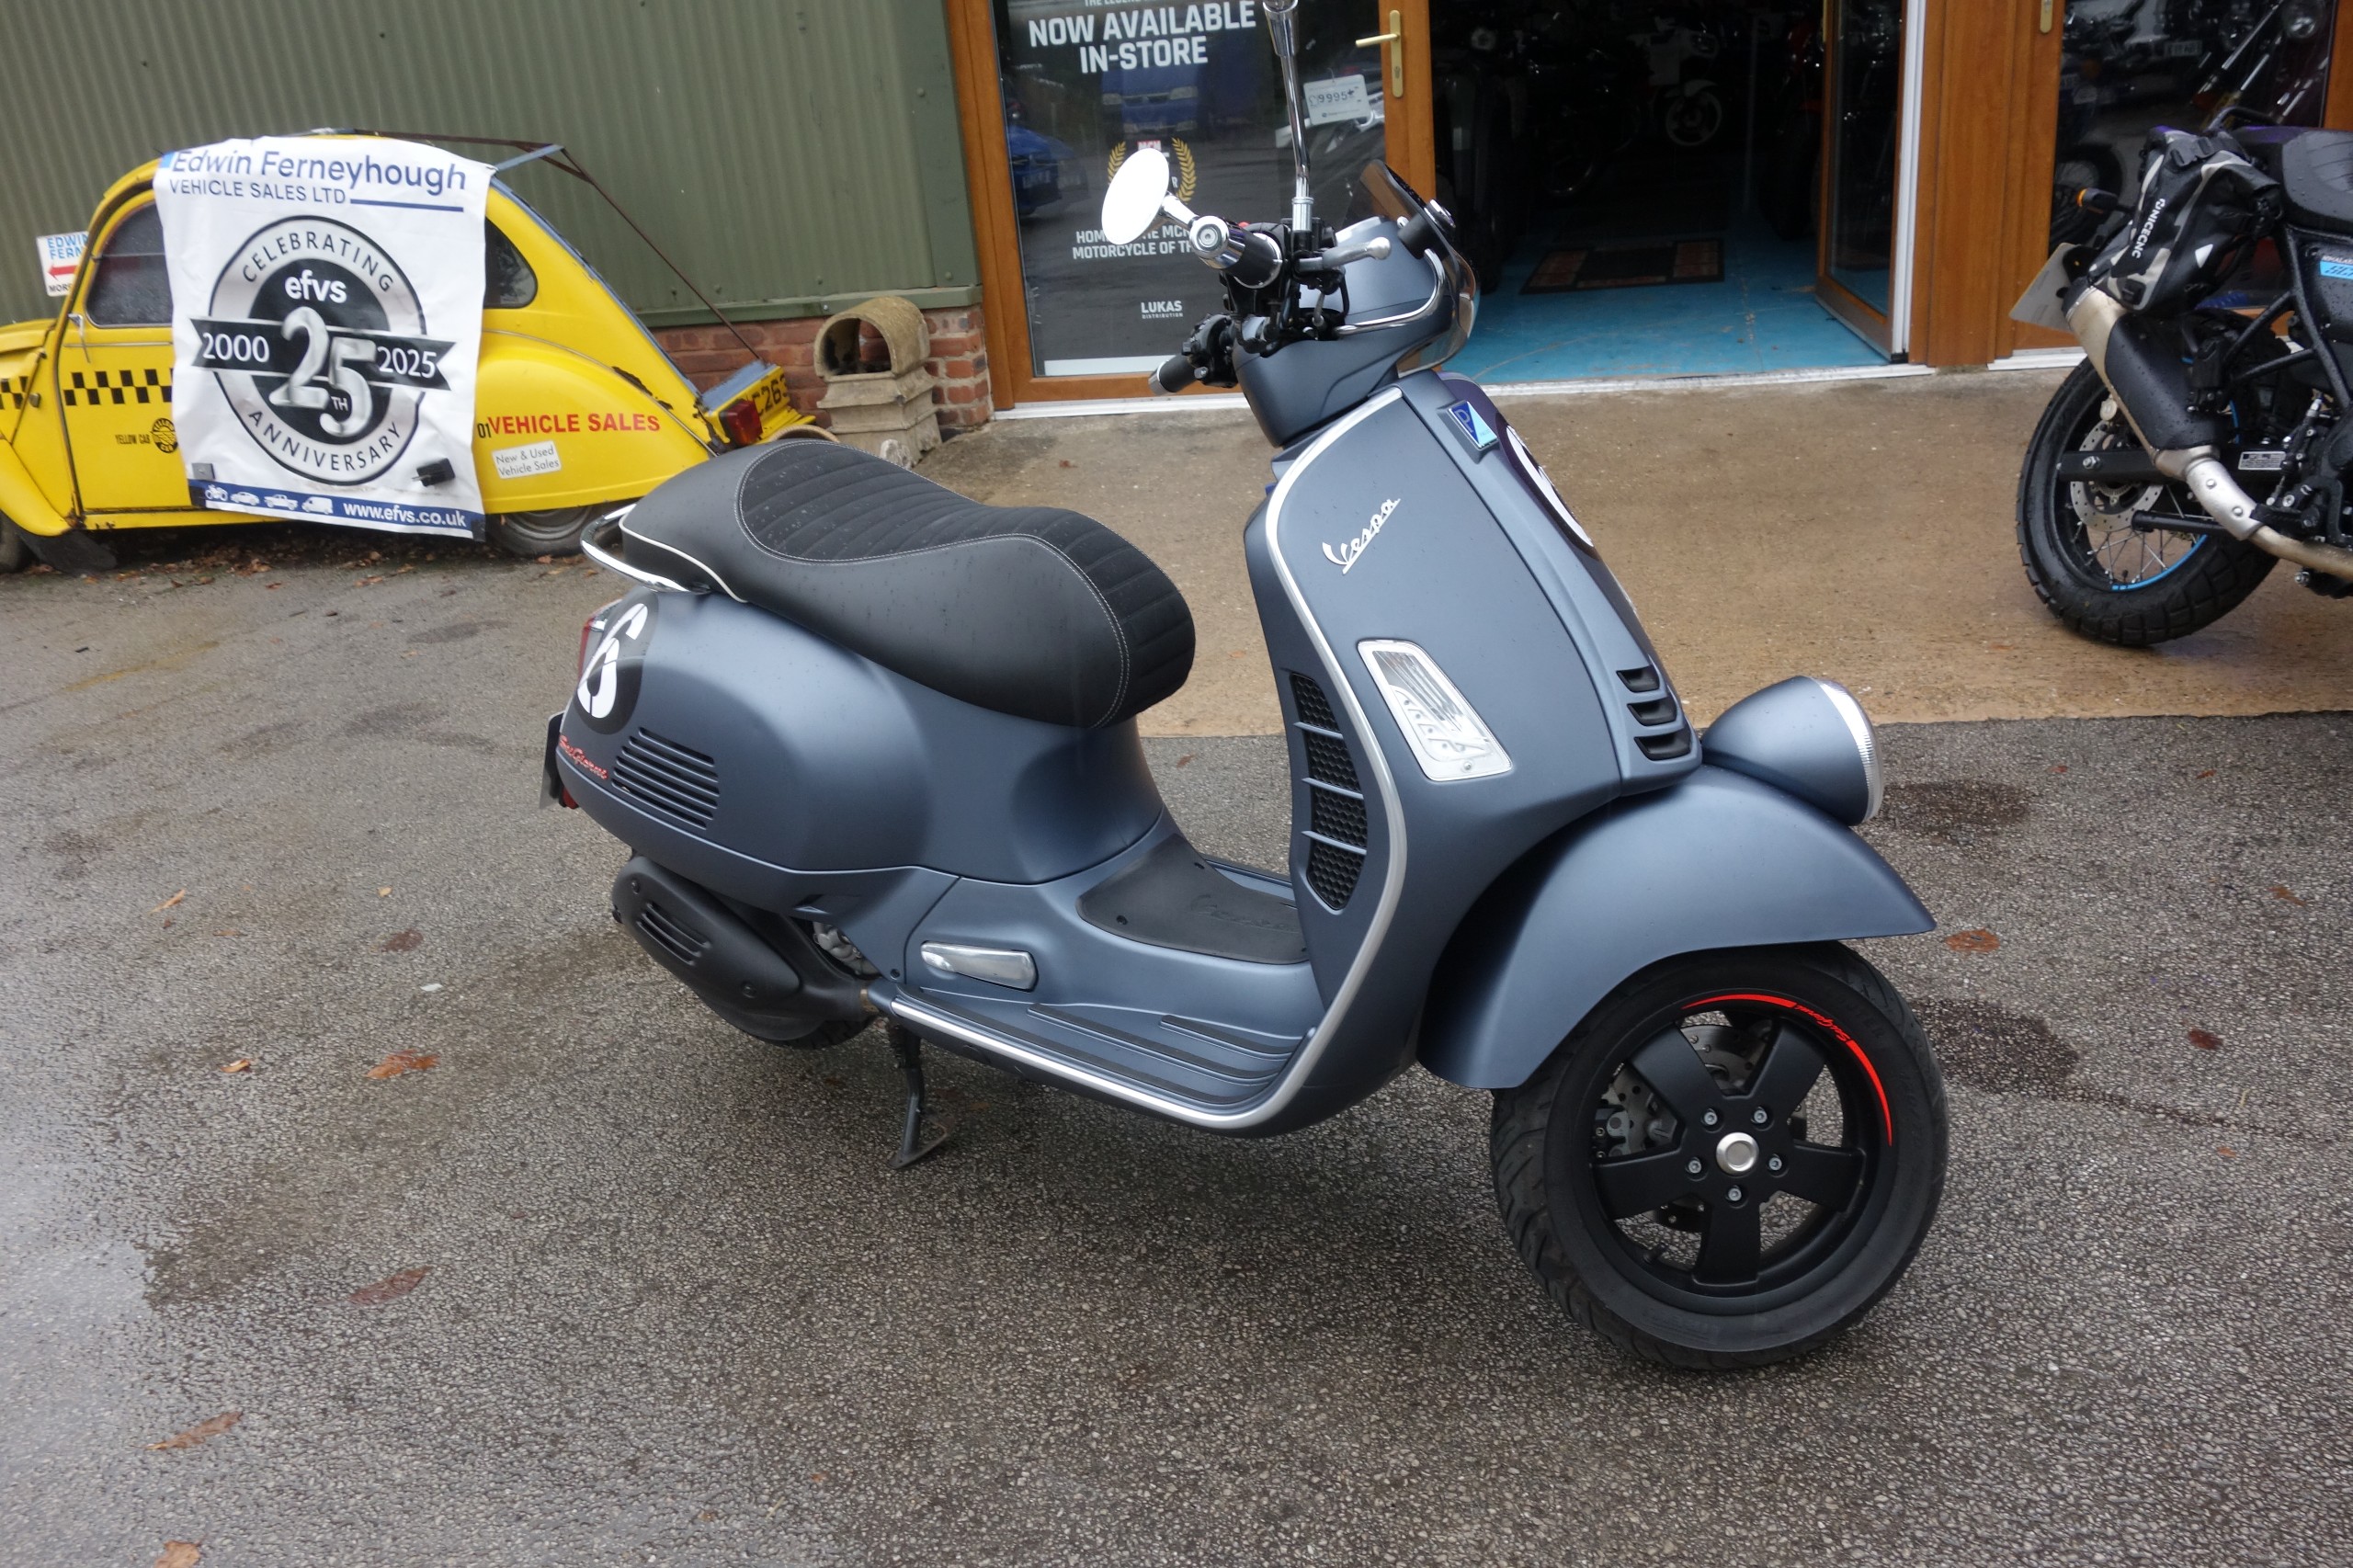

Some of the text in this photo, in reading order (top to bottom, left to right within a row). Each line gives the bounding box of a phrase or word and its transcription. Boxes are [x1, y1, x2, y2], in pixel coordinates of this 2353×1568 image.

[1029, 0, 1256, 47] NOW AVAILABLE
[1079, 36, 1209, 74] IN-STORE
[171, 151, 467, 196] Edwin Ferneyhough
[169, 179, 347, 204] VEHICLE SALES LTD
[1072, 240, 1192, 259] MOTORCYCLE OF TH
[1075, 230, 1107, 244] HOM
[243, 231, 394, 292] CELEBRATING
[284, 268, 347, 303] efvs
[1141, 301, 1182, 313] LUKAS
[202, 332, 270, 363] 2000
[377, 346, 437, 379] 2025
[268, 305, 377, 437] 25
[331, 396, 349, 411] TH
[487, 413, 661, 435] VEHICLE SALES
[249, 410, 401, 472] ANNIVERSARY
[495, 445, 554, 465] New & Used
[498, 458, 560, 477] Vehicle Sales
[343, 503, 467, 528] www.efvs.co.uk
[1322, 498, 1402, 574] Vespa
